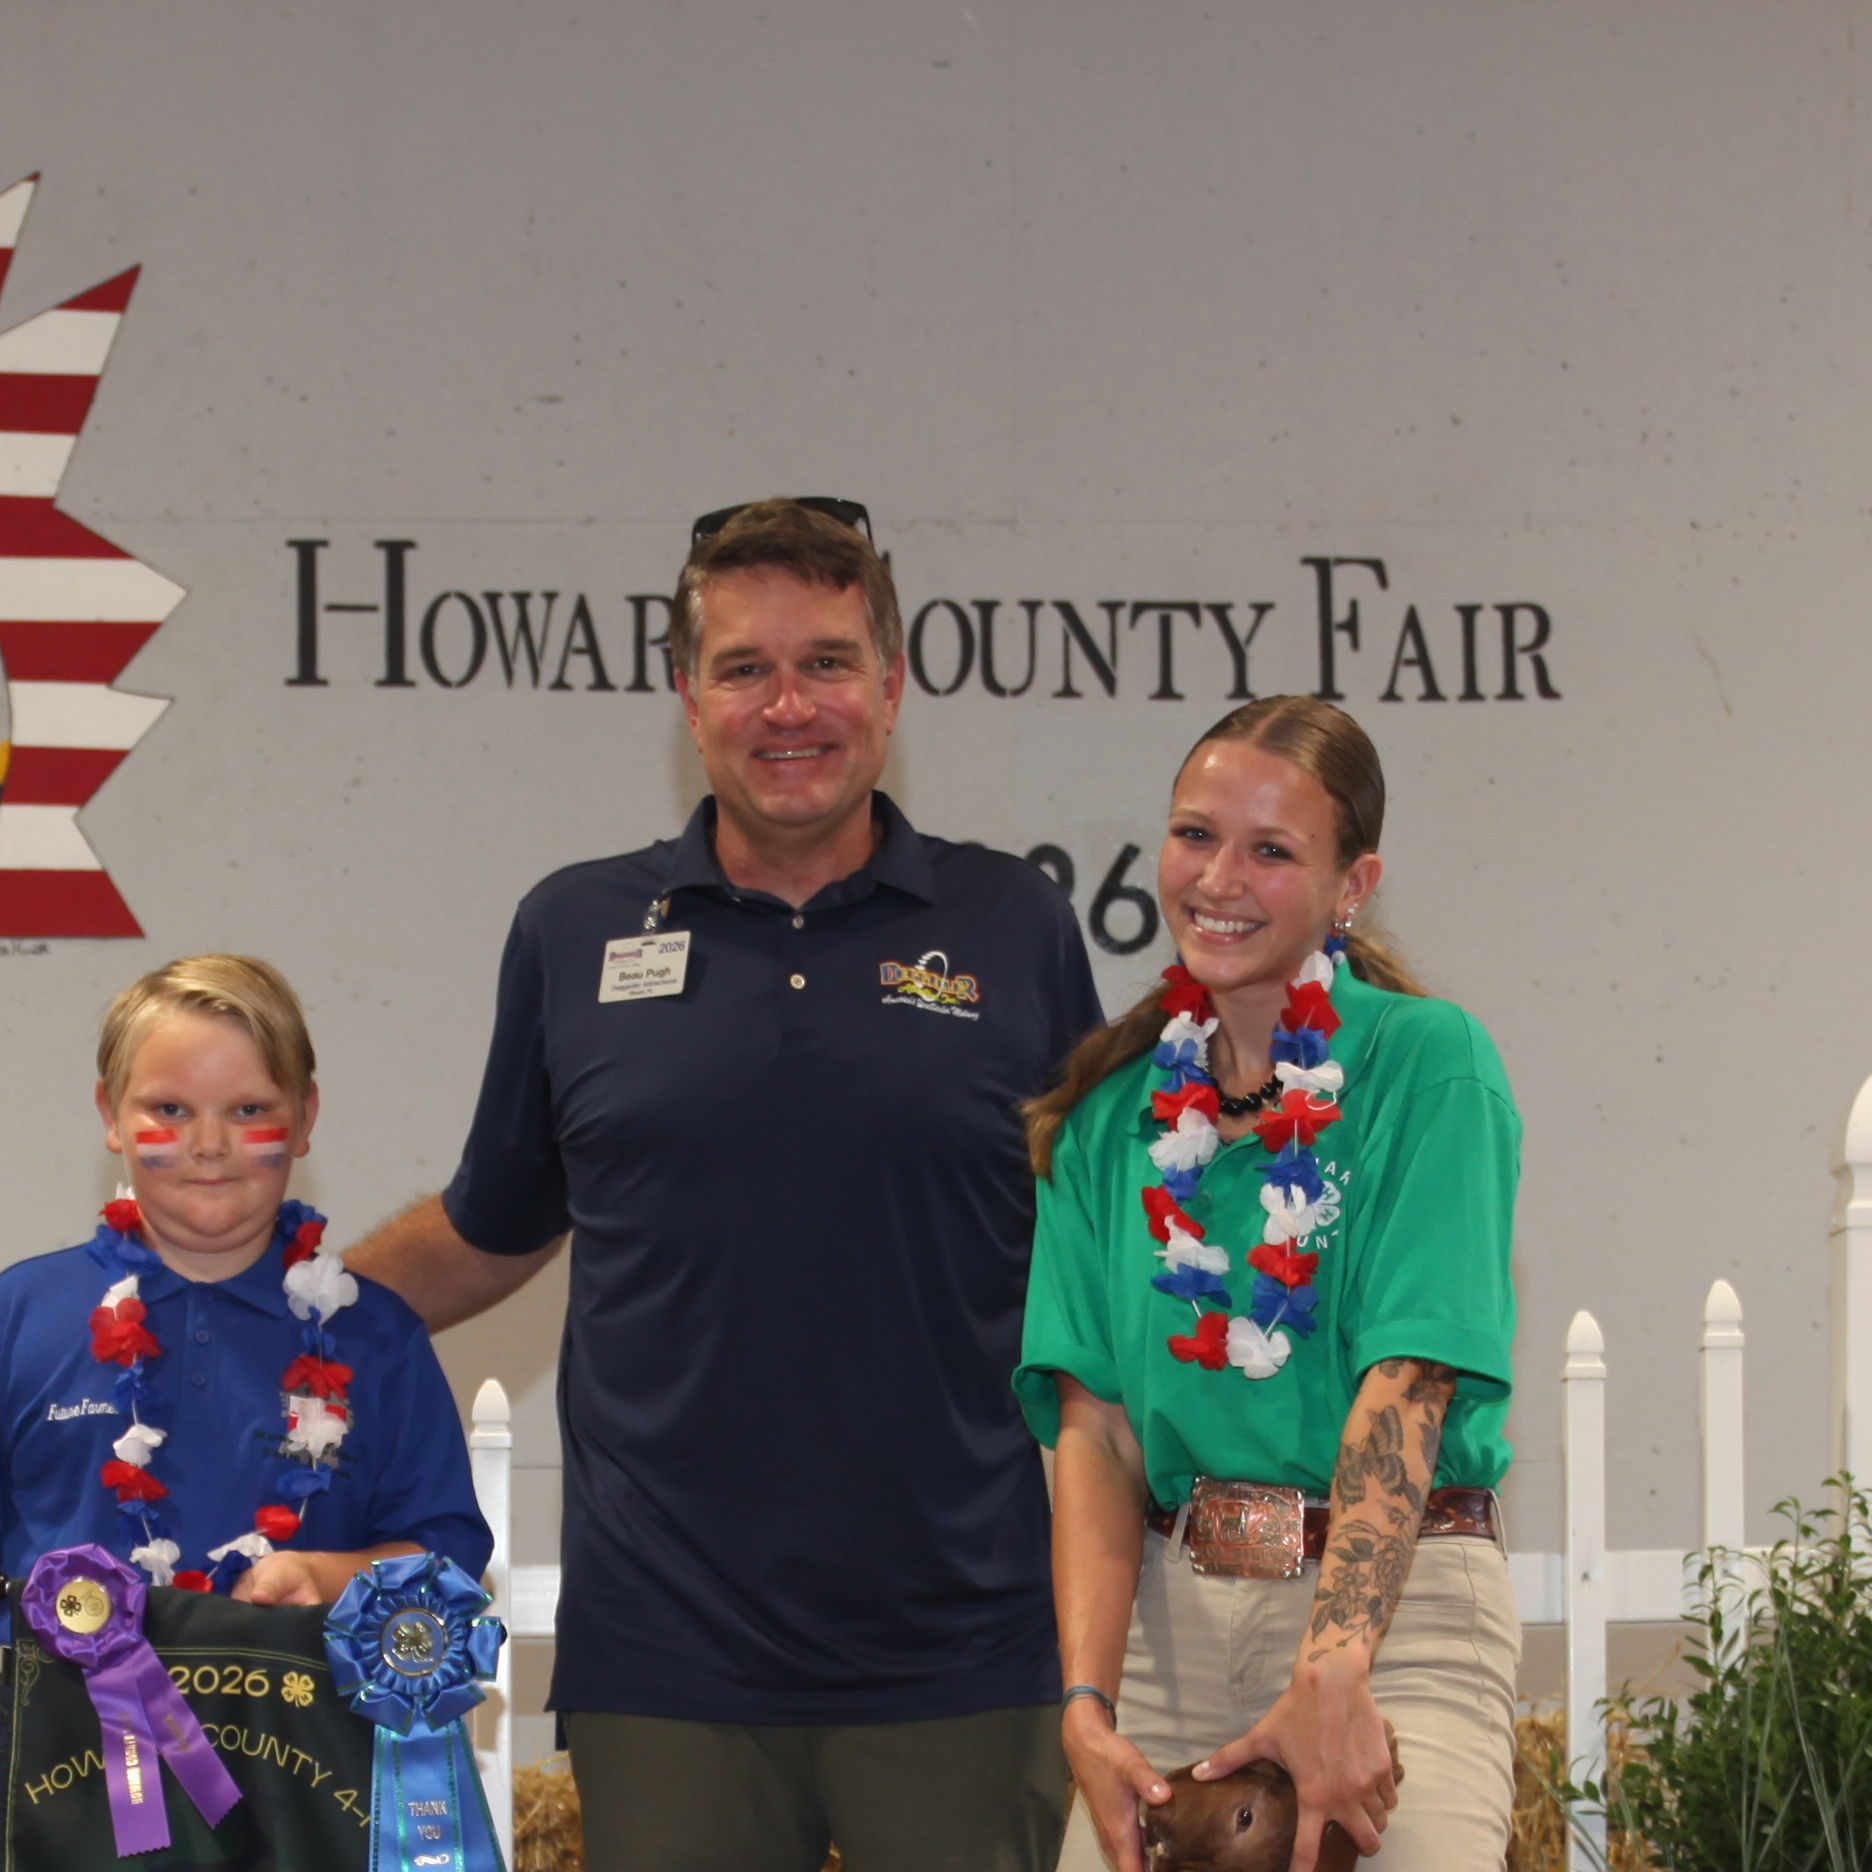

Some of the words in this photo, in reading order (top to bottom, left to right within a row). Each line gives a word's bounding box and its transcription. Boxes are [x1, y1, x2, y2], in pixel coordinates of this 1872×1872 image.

[284, 539, 678, 693] HOWAR
[882, 552, 1275, 702] OUNTY
[1299, 556, 1562, 702] FAIR
[659, 940, 686, 954] 2026
[646, 966, 671, 979] Pugh
[169, 1665, 271, 1698] 2026
[24, 1749, 106, 1805] HOW
[200, 1723, 333, 1789] COUNTY
[407, 1801, 448, 1817] THANK
[417, 1824, 443, 1840] YOU
